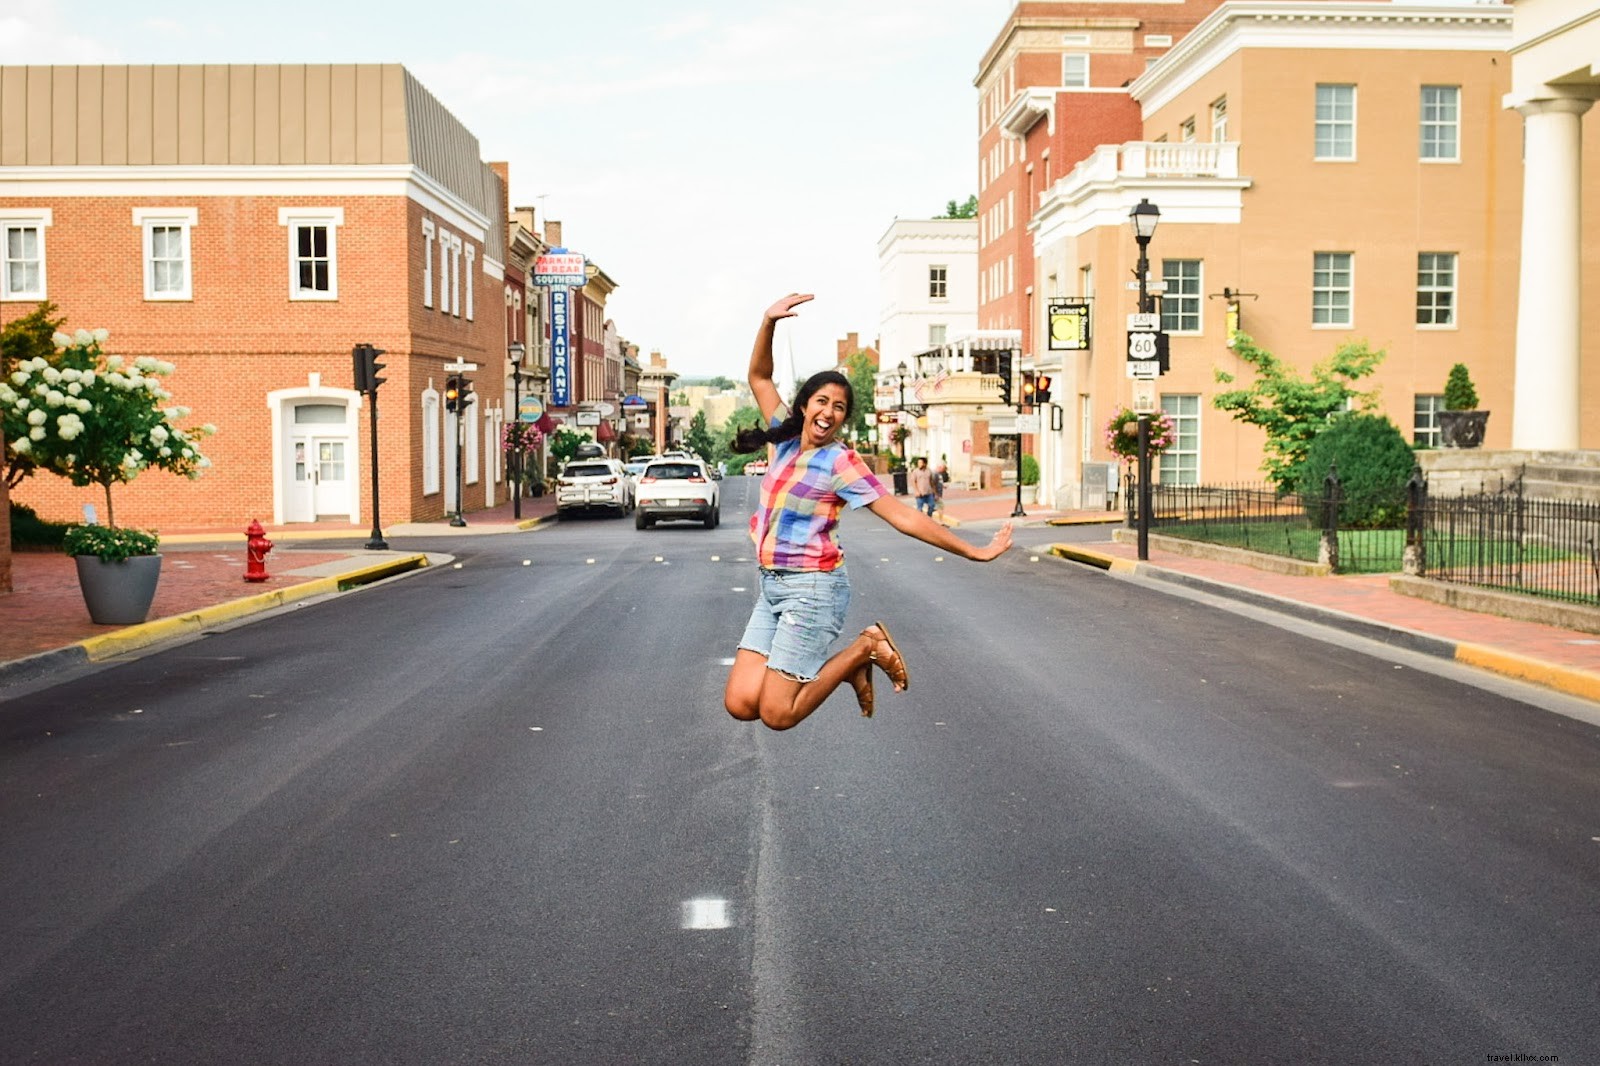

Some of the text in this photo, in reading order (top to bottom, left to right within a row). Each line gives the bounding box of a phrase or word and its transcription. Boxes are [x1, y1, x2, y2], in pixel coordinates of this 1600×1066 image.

[535, 276, 584, 284] SOUTHERN
[1050, 306, 1080, 315] Corner
[1080, 316, 1088, 341] Stone
[554, 293, 566, 398] RESTAURANT
[1135, 340, 1151, 352] 60
[1133, 362, 1151, 370] WEST
